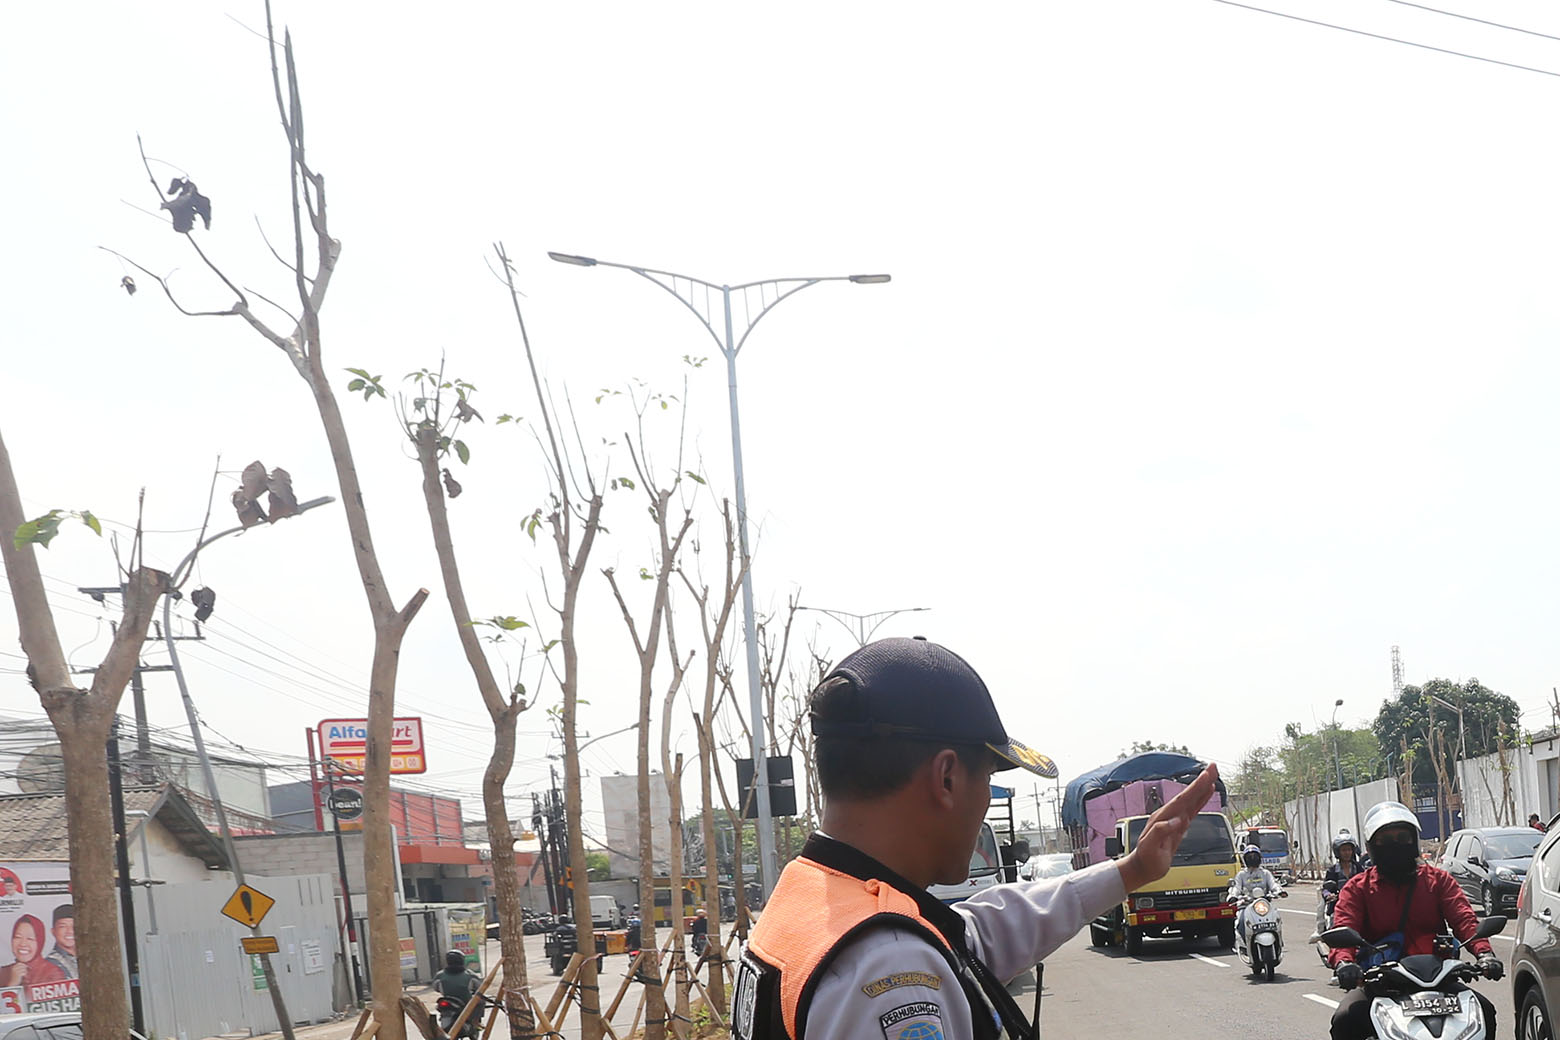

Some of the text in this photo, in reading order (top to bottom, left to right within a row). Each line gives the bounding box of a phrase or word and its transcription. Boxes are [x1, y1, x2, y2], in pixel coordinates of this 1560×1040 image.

[32, 984, 79, 1001] RISMA
[866, 979, 892, 994] DINAS
[62, 999, 80, 1013] HA
[1402, 996, 1458, 1010] L 5154 RY
[882, 1004, 939, 1024] PERHUBUNGAN
